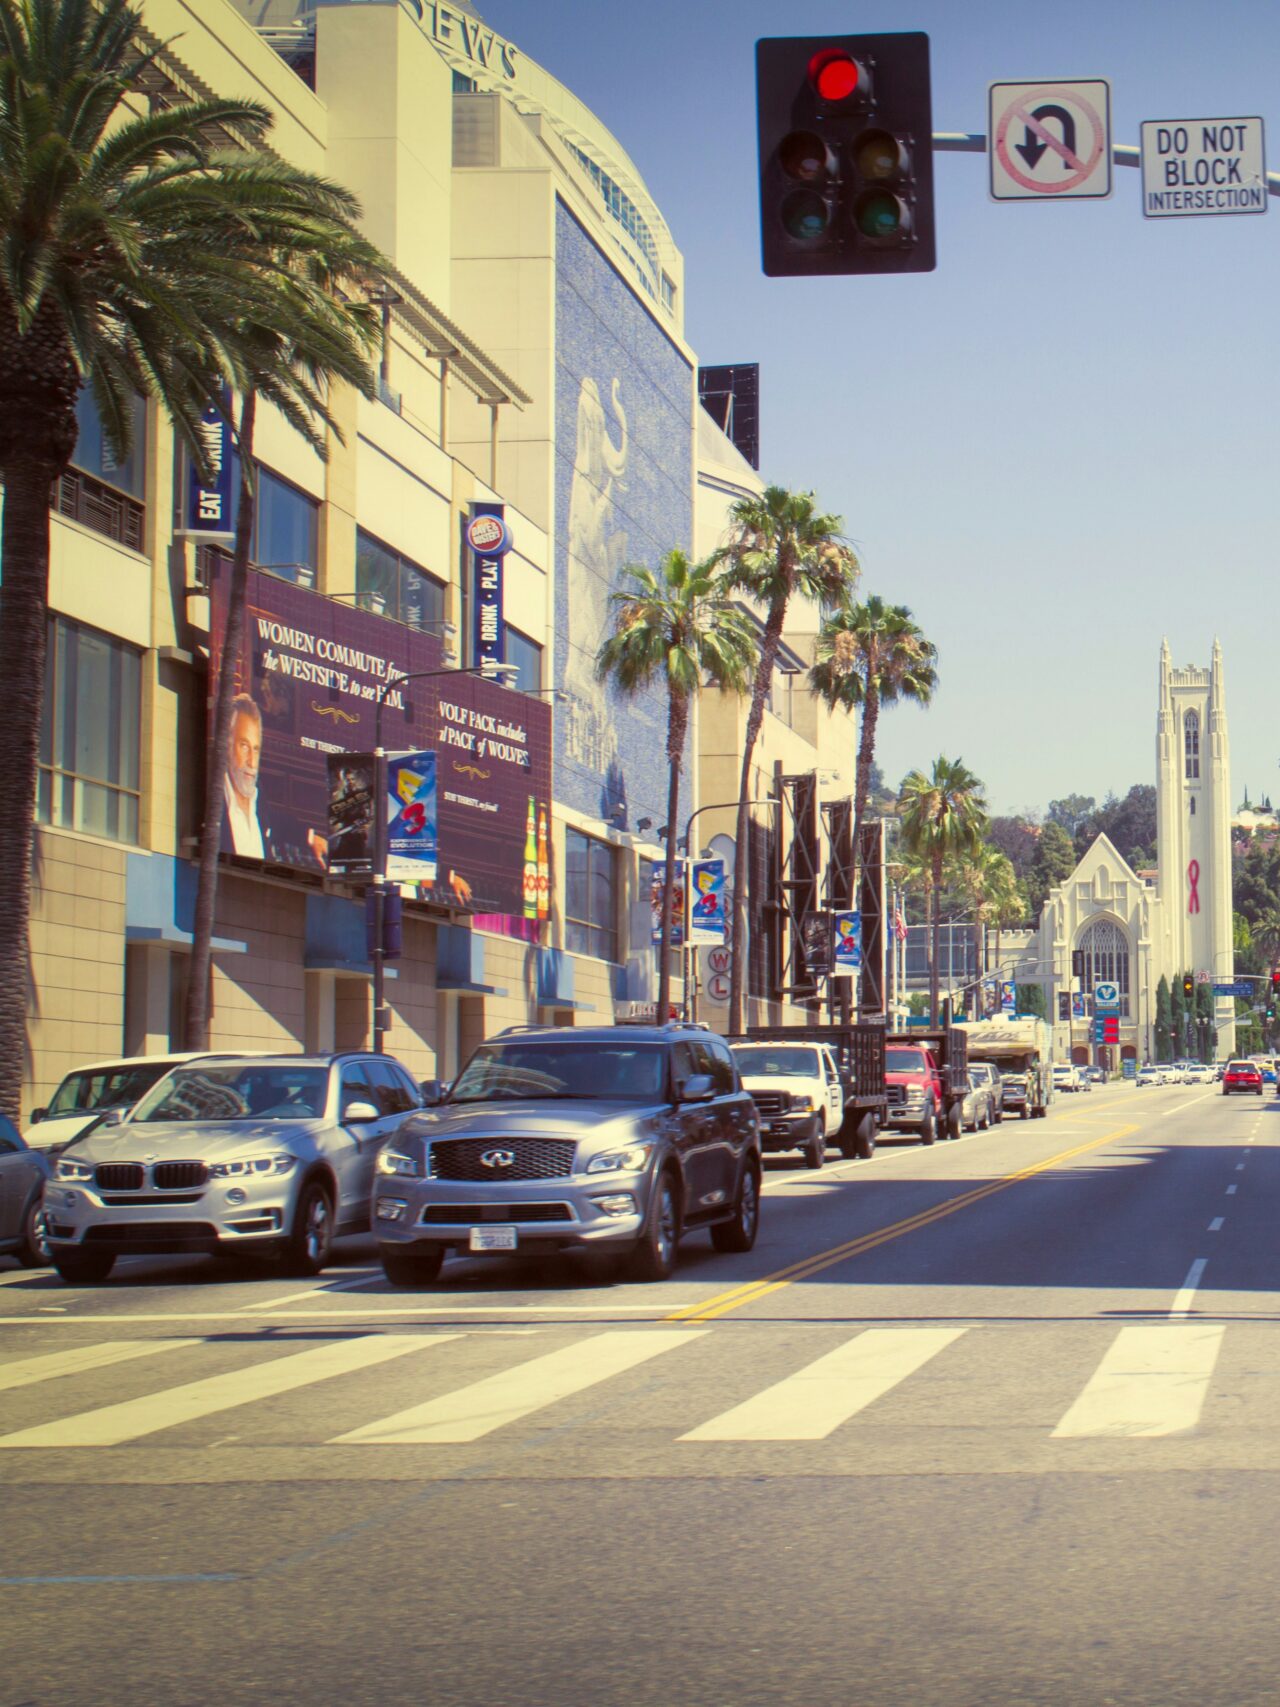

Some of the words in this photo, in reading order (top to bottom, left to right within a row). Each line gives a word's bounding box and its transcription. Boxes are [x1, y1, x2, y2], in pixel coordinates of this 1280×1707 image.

[1157, 127, 1188, 154] DO
[1202, 125, 1247, 153] NOT
[1164, 158, 1242, 187] BLOCK
[1148, 188, 1261, 210] INTERSECTION
[199, 490, 222, 520] EAT
[481, 559, 498, 589] PLAY
[481, 603, 498, 642] DRINK
[257, 618, 315, 655] WOMEN
[316, 638, 386, 678] COMMUTE
[278, 653, 349, 693] WESTSIDE
[350, 680, 361, 696] to
[361, 686, 376, 701] see
[469, 710, 497, 734] PACK
[448, 727, 476, 751] PACK
[488, 739, 530, 767] WOLVES
